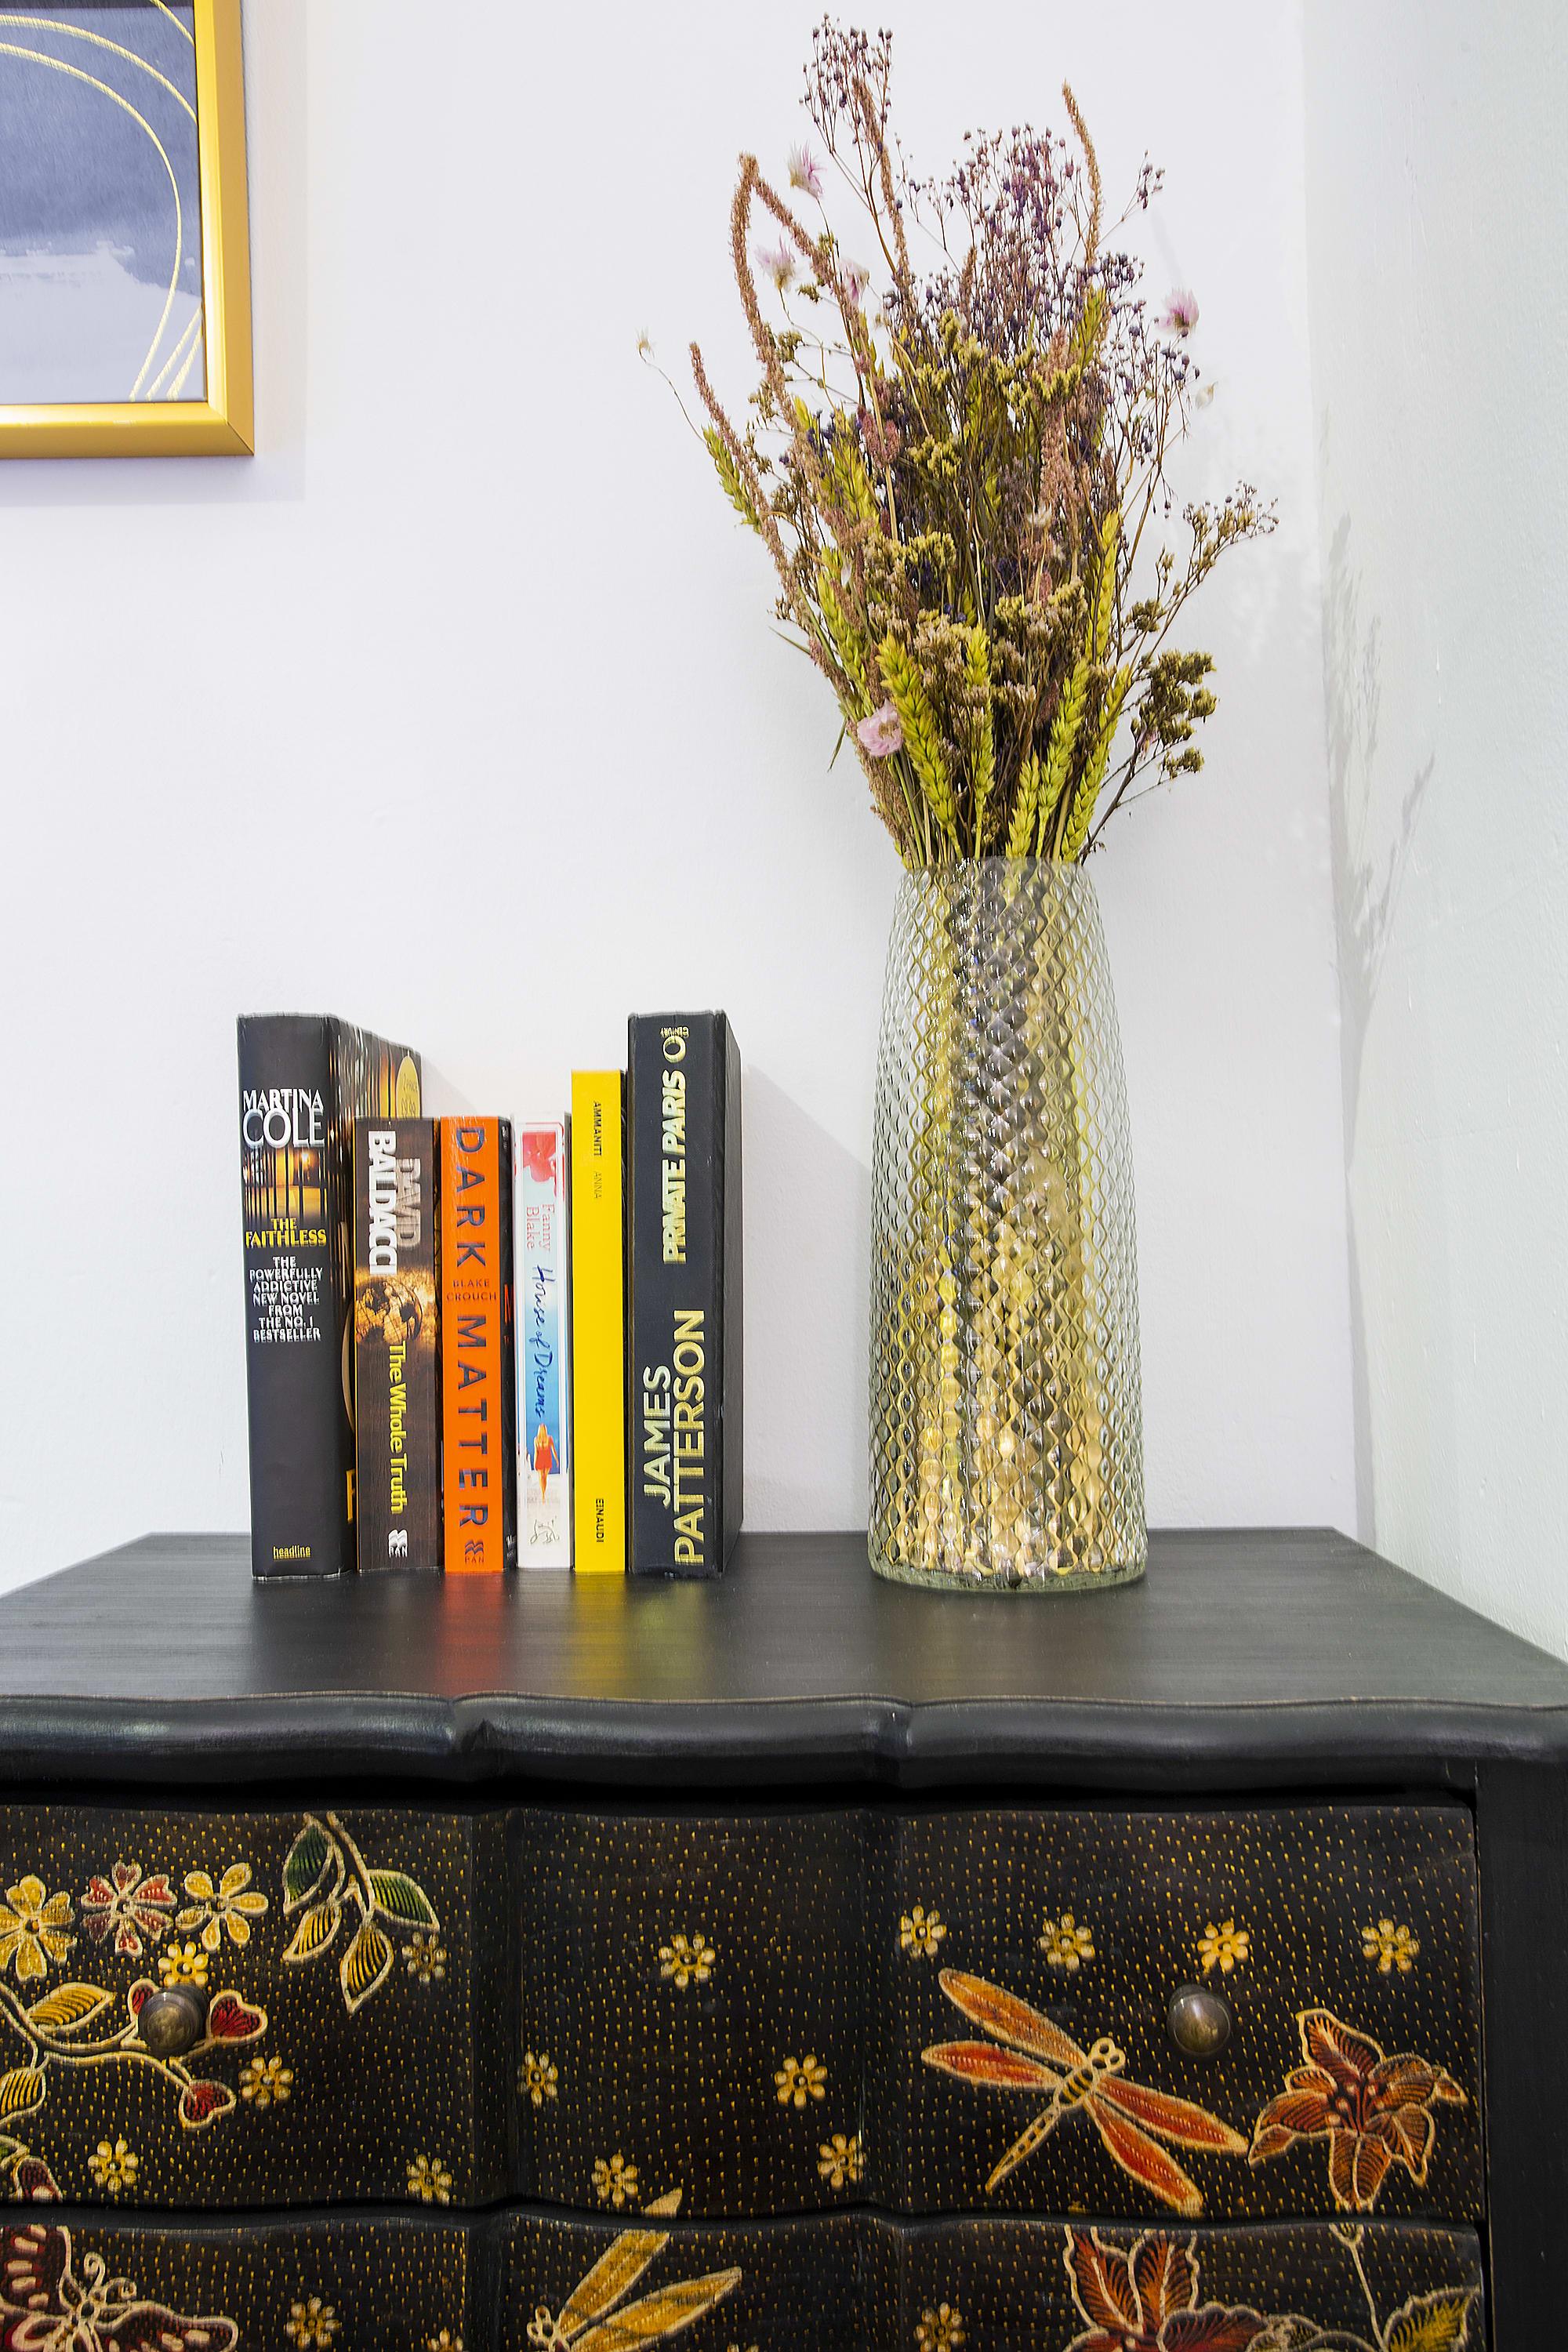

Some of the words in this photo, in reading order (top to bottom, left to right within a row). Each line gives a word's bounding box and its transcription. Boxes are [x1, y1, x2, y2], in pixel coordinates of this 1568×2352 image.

[242, 1088, 324, 1113] MARTINA
[662, 1069, 686, 1156] PARIS
[242, 1108, 325, 1149] COLE
[368, 1131, 397, 1275] BALDACCI
[395, 1158, 422, 1248] DAVID
[456, 1126, 486, 1268] DARK
[662, 1159, 687, 1265] PRIVATE
[245, 1229, 327, 1248] FAITHLESS
[270, 1218, 298, 1231] THE
[526, 1207, 541, 1251] Blake
[539, 1203, 555, 1252] Fanny
[249, 1268, 323, 1283] POWERFULLY
[272, 1256, 297, 1269] THE
[452, 1279, 489, 1287] BLAKE
[252, 1292, 278, 1307] NEW
[281, 1291, 320, 1305] NOVEL
[253, 1279, 318, 1294] ADDICTIVE
[446, 1292, 496, 1301] CROUCH
[532, 1265, 557, 1327] House
[259, 1316, 282, 1330] THE
[268, 1304, 303, 1319] FROM
[253, 1328, 321, 1343] BESTSELLER
[528, 1330, 550, 1350] of
[389, 1341, 406, 1384] The
[533, 1350, 554, 1418] Dreams
[390, 1382, 407, 1454] Whole
[457, 1315, 488, 1527] MATTER
[643, 1365, 671, 1509] JAMES
[673, 1310, 705, 1566] PATTERSON
[390, 1454, 408, 1515] Truth
[596, 1498, 604, 1543] EINAUDI
[273, 1544, 311, 1560] headline
[389, 1544, 408, 1559] PAN
[465, 1555, 485, 1564] PAN
